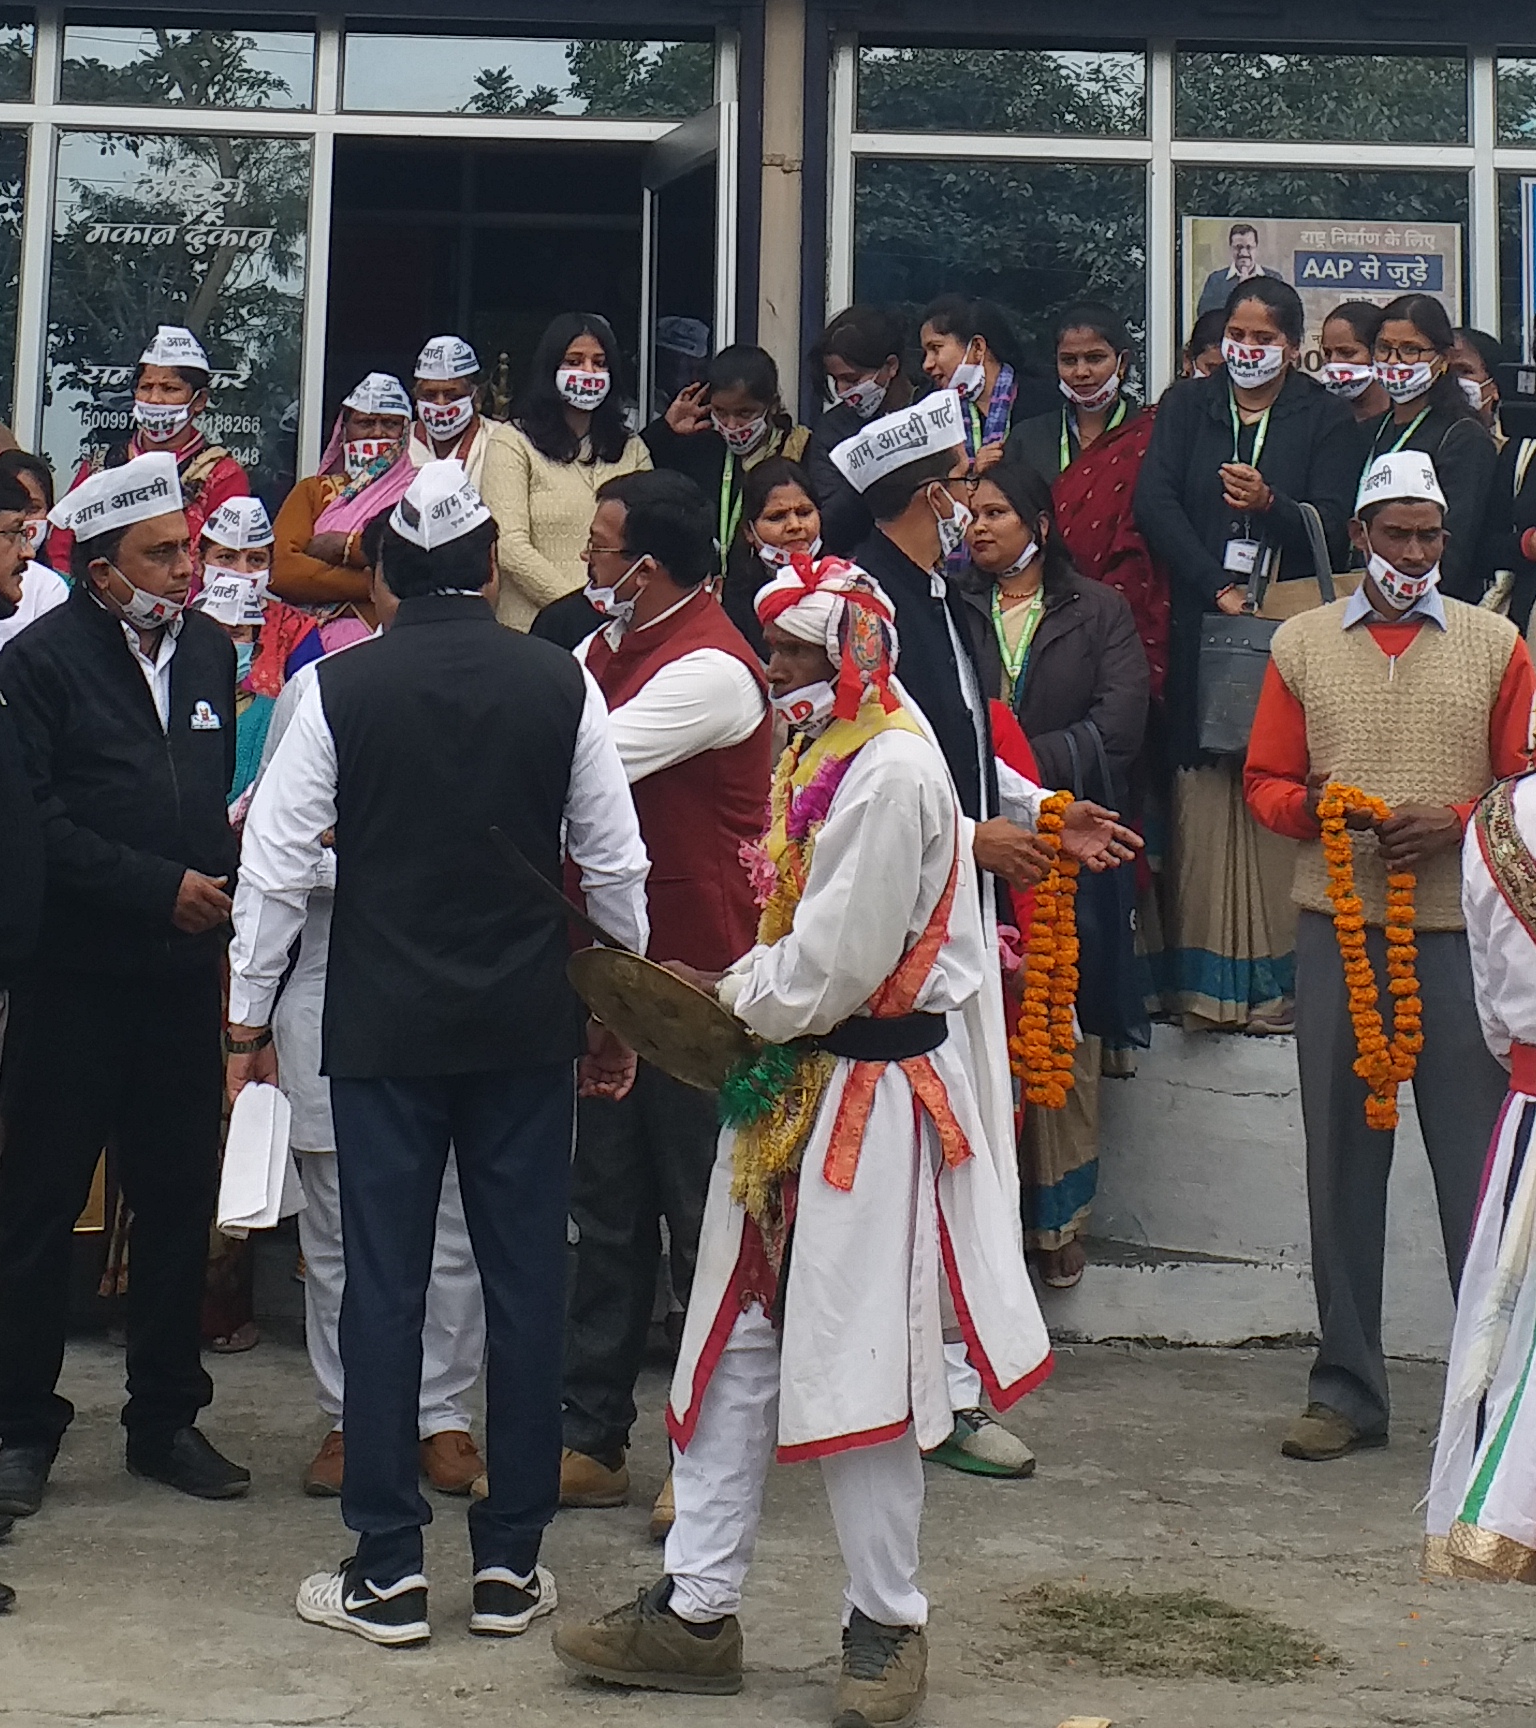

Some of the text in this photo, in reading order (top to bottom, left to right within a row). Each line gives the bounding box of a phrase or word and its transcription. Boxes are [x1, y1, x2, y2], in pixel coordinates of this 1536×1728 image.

[85, 222, 277, 253] मकान दुकान
[1331, 227, 1436, 249] निर्माण के लिए
[1303, 258, 1354, 279] AAP
[1359, 255, 1380, 280] से
[846, 414, 927, 471] आम आदमी
[74, 476, 168, 524] आम आदमी
[431, 494, 462, 519] आम
[211, 583, 238, 600] पार्टी
